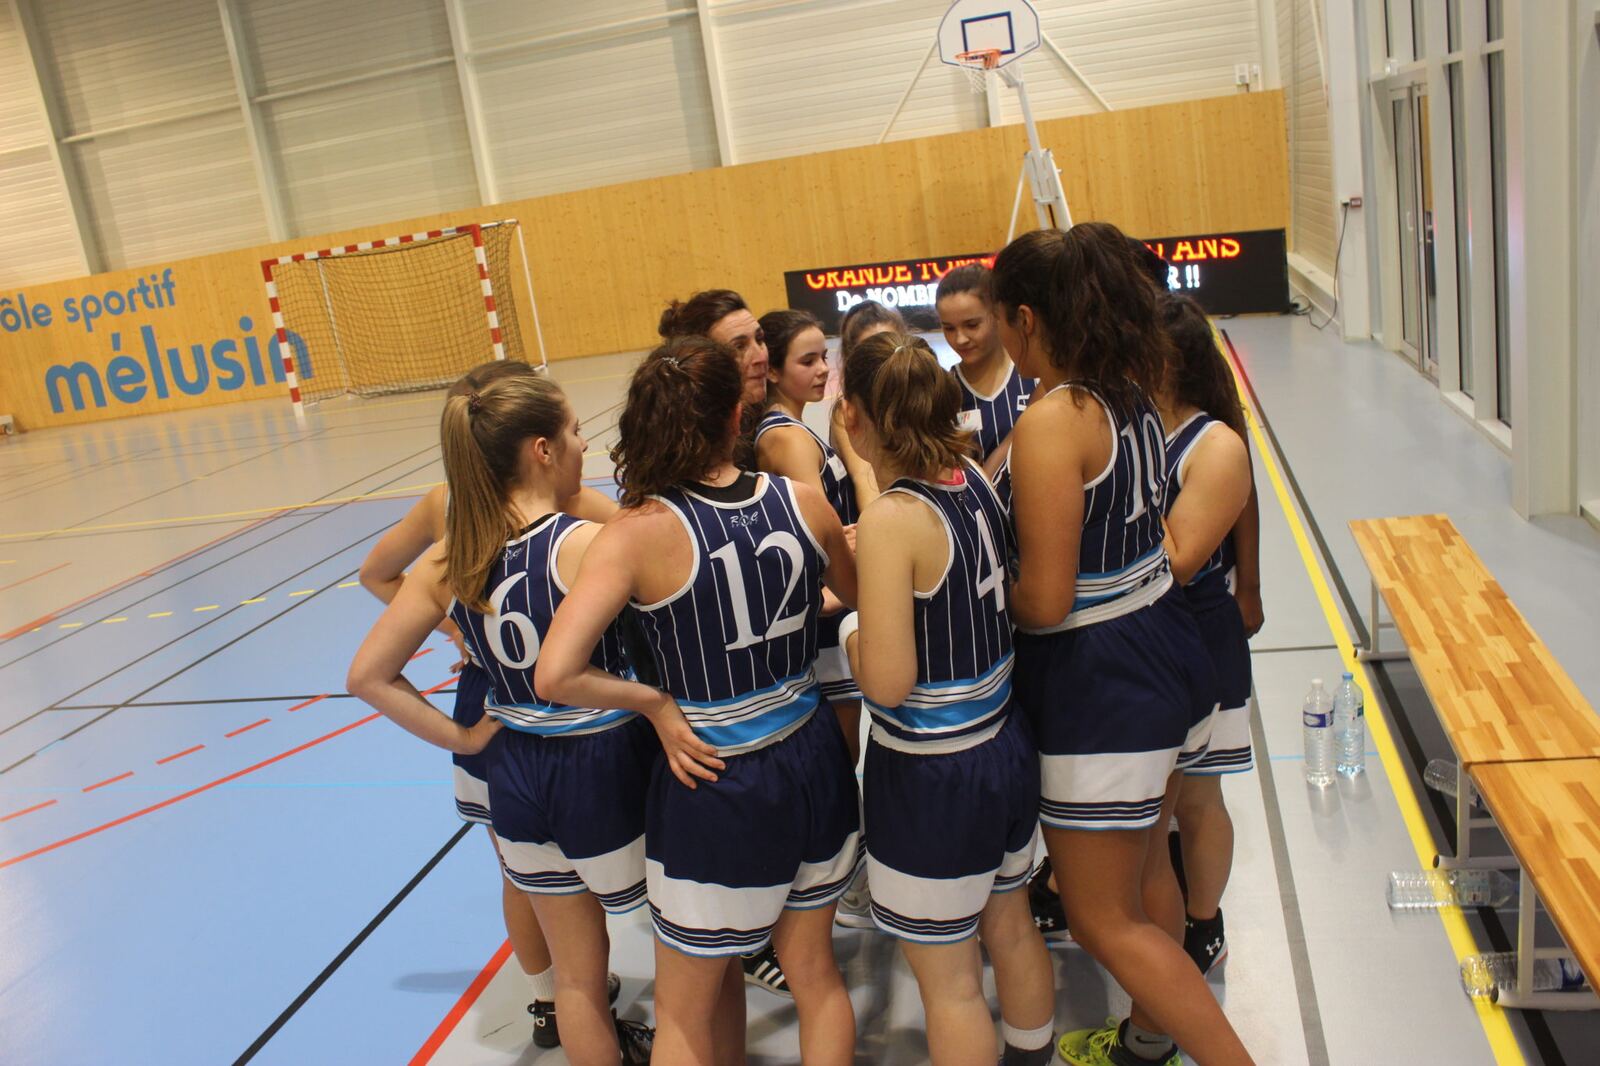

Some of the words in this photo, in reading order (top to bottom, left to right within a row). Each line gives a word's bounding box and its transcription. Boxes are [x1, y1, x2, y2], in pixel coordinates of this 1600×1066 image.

[63, 268, 176, 333] sportif
[45, 316, 314, 414] mélusin
[1120, 412, 1167, 525] 10
[709, 530, 810, 652] 12
[975, 508, 1005, 613] 4
[484, 571, 540, 670] 6
